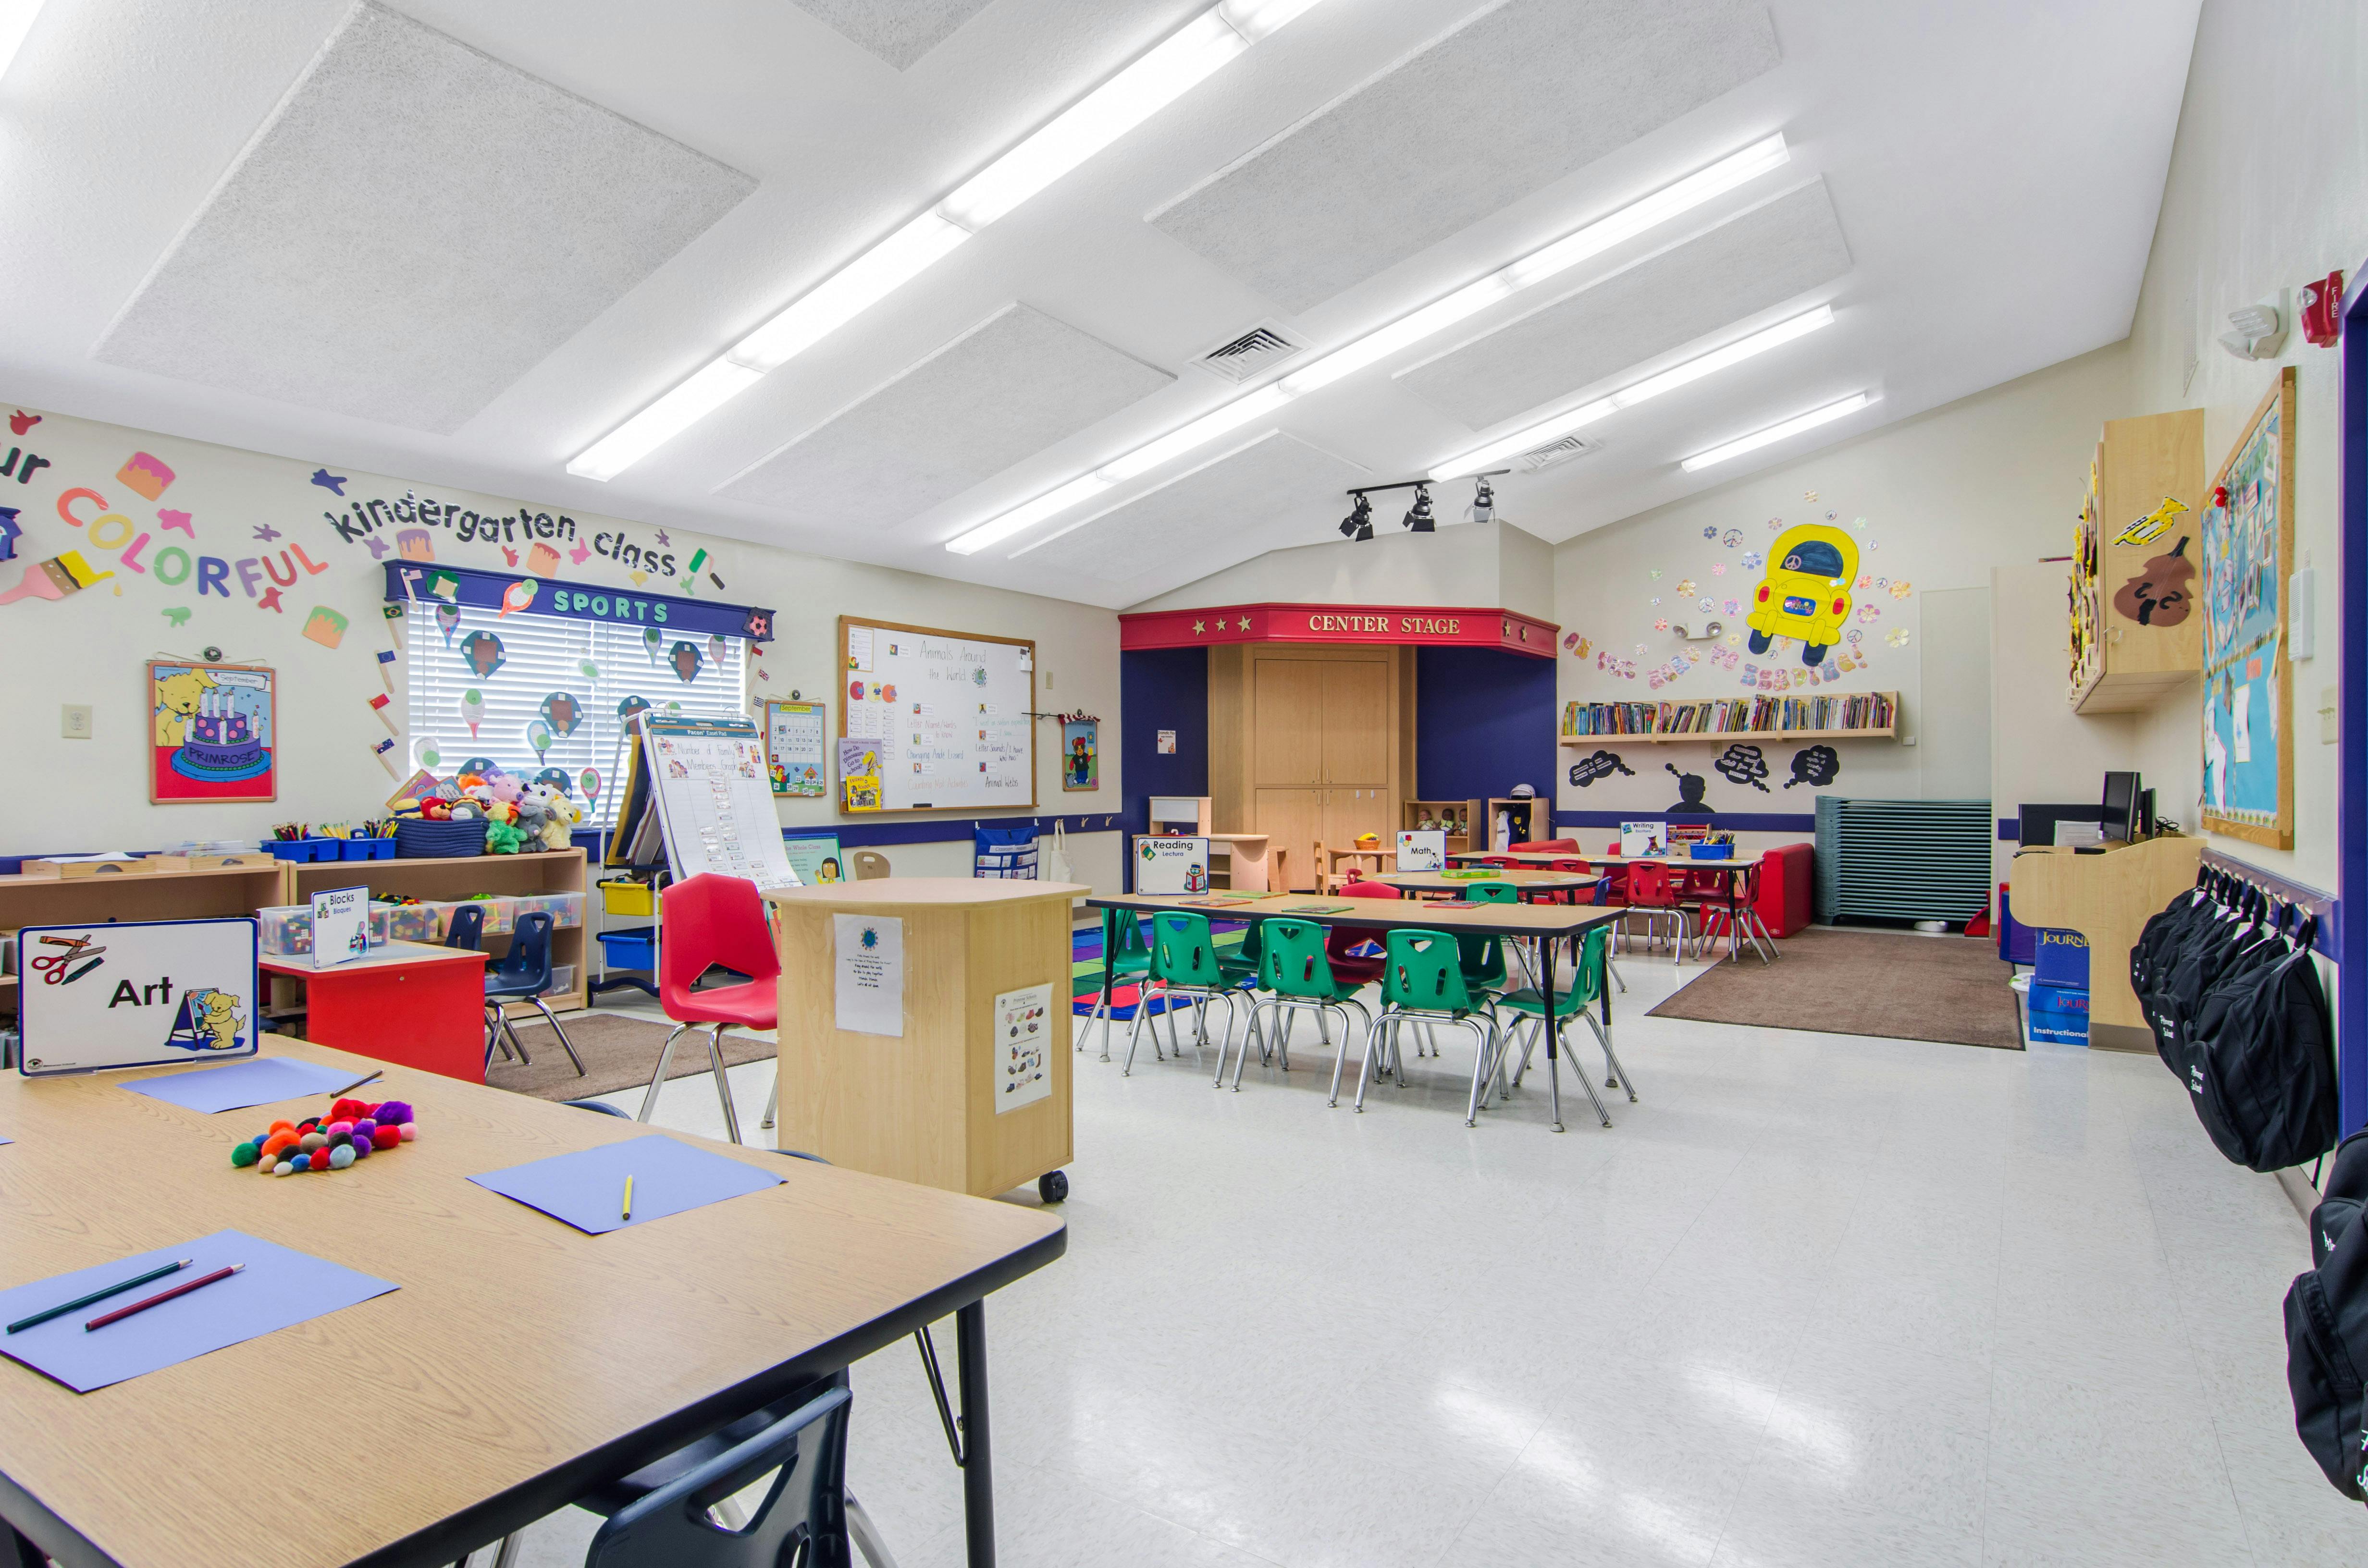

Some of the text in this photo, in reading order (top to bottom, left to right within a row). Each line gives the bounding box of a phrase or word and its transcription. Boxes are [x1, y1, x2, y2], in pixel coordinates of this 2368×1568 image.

[323, 489, 676, 576] kindergarten class
[57, 487, 329, 598] COLORFUL
[554, 590, 667, 623] SPORTS
[1309, 615, 1460, 634] CENTER STAGE
[920, 640, 953, 661] Animals
[960, 647, 986, 663] Around
[220, 674, 258, 685] September
[928, 667, 966, 681] the World
[907, 718, 922, 729] Letter
[678, 744, 700, 755] Number
[717, 745, 735, 759] Family
[907, 748, 929, 761] Changing
[948, 749, 963, 760] Lizard
[975, 743, 989, 752] Letter
[189, 747, 256, 765] PRIMROSE
[687, 759, 738, 774] Members Graph
[986, 774, 1018, 788] Animal Webs
[1154, 841, 1193, 851] Reading
[330, 893, 355, 905] Blocks
[108, 977, 173, 1008] Art
